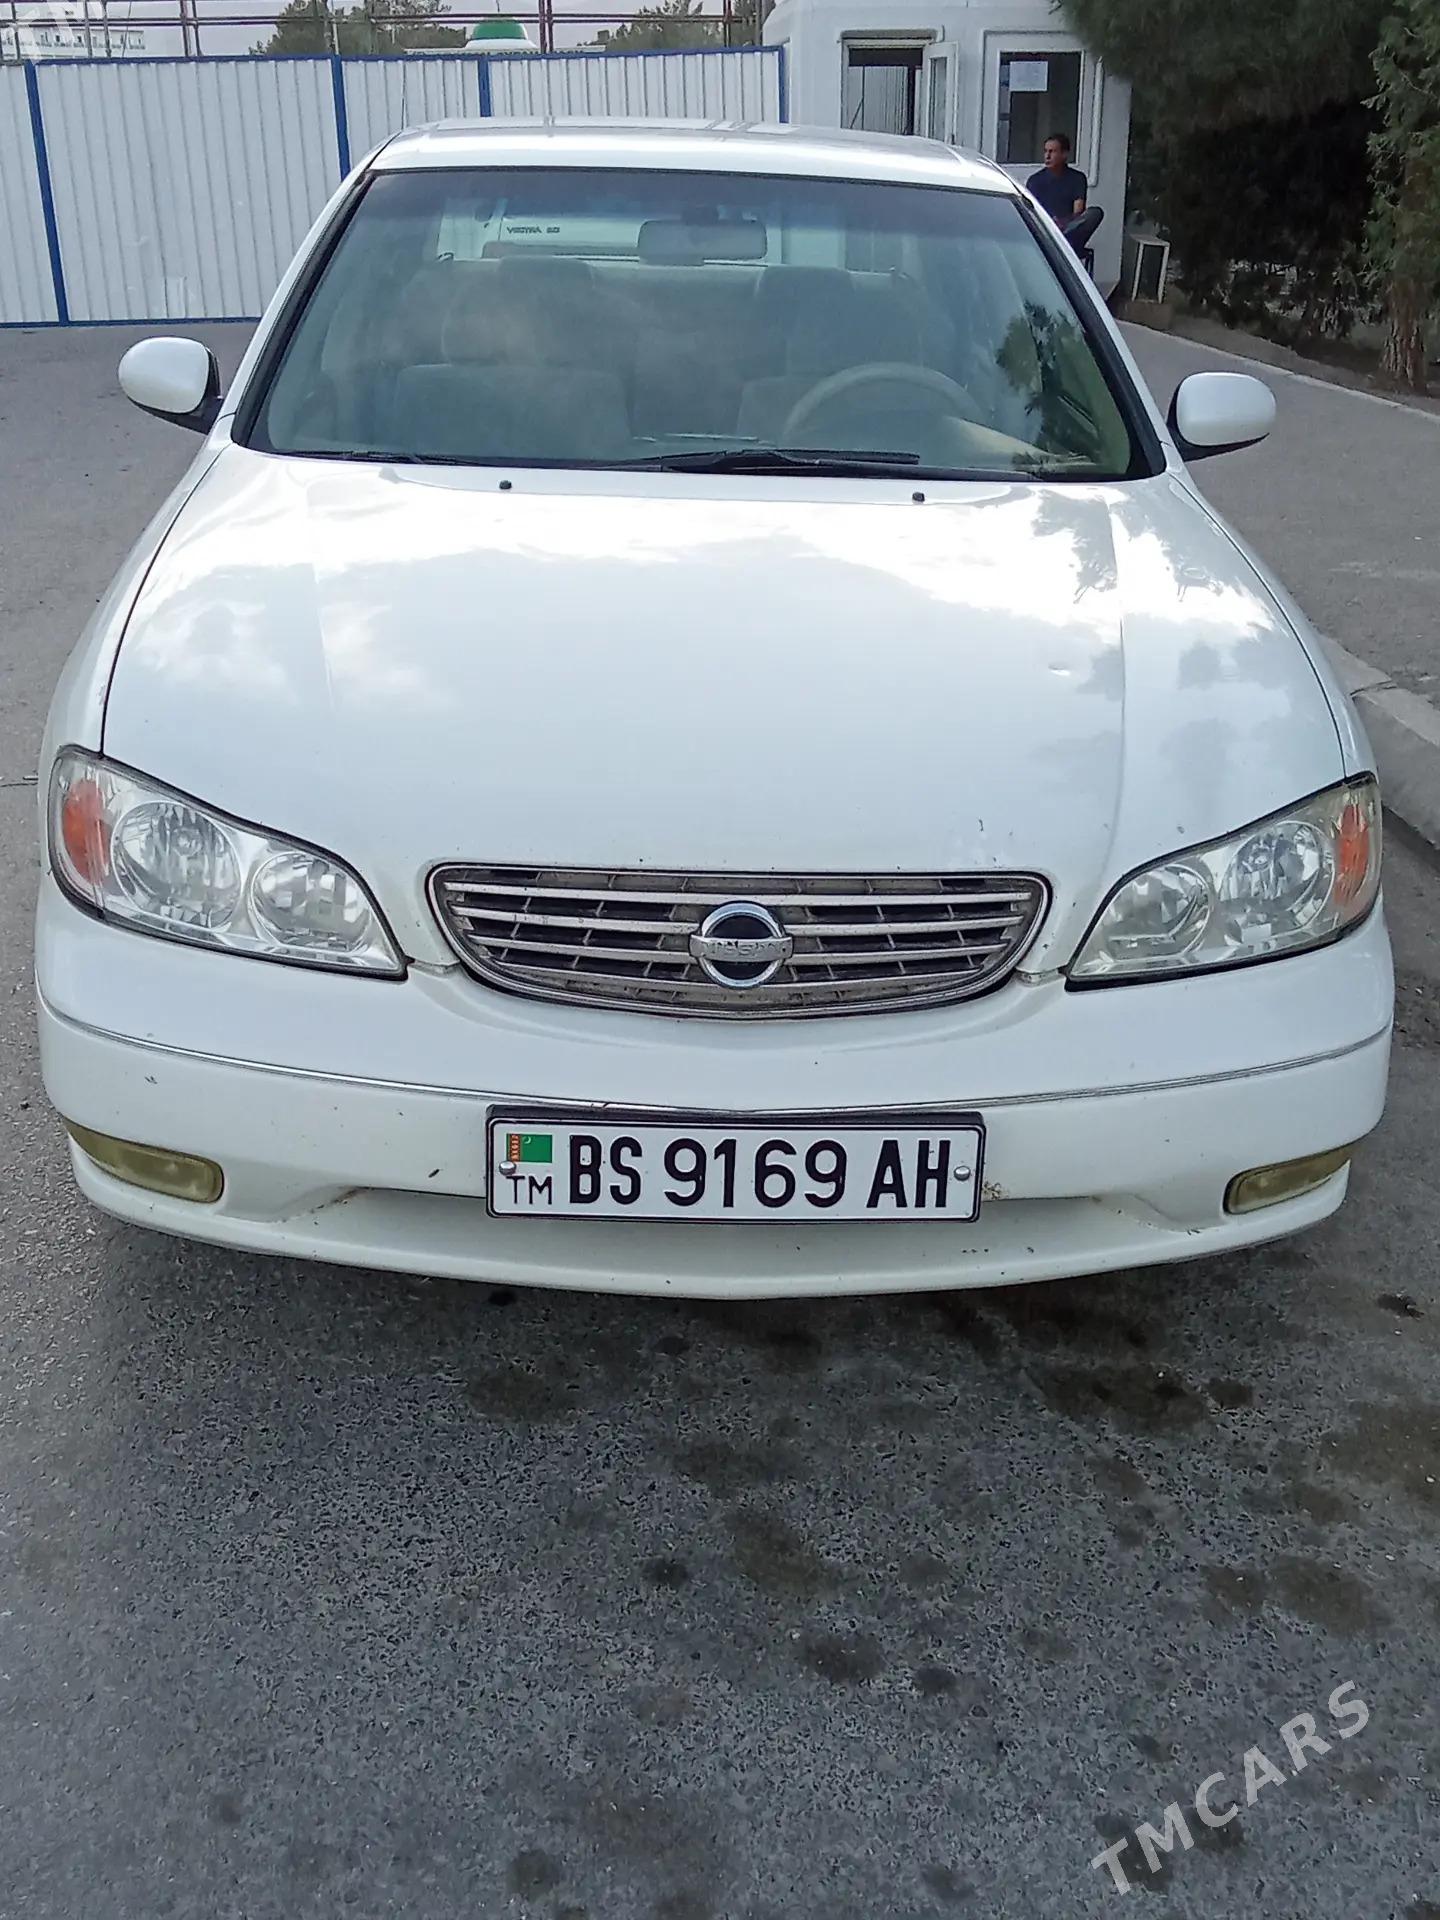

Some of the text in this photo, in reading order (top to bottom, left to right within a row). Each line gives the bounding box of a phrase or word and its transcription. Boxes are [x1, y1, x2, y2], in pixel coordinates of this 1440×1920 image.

[506, 1175, 552, 1205] TM
[569, 1134, 951, 1209] BS 9169 AH
